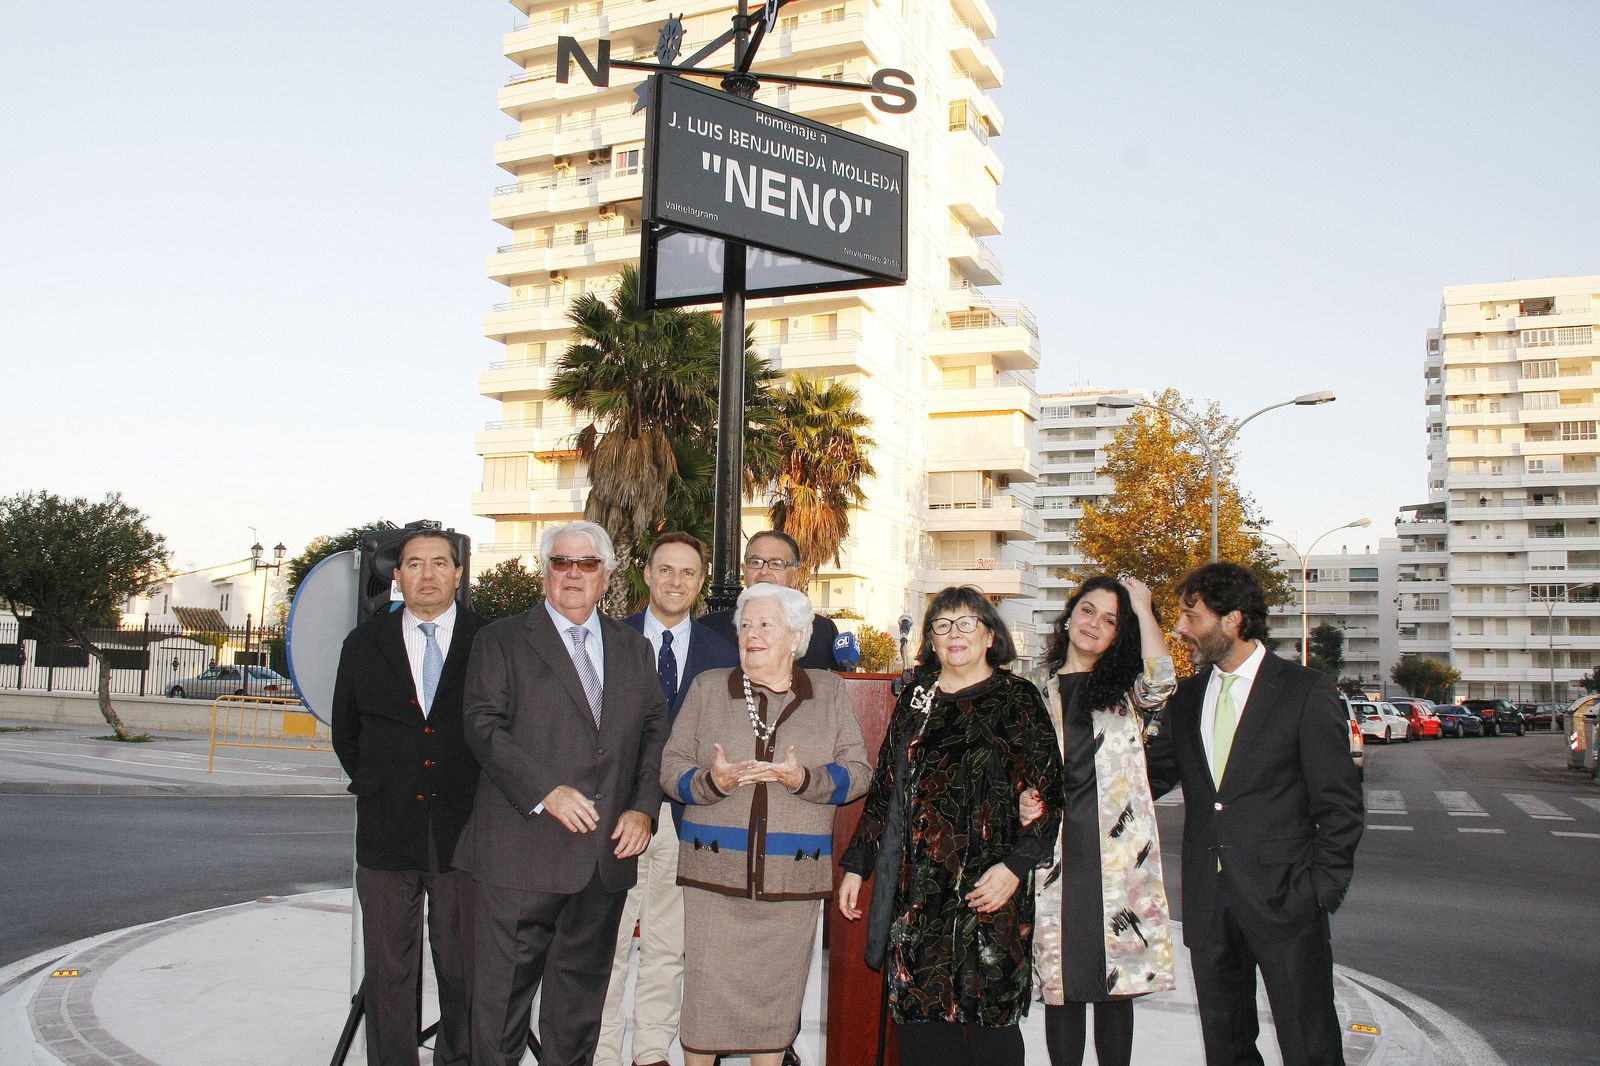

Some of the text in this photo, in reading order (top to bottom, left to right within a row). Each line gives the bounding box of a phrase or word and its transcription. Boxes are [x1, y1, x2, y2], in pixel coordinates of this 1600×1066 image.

[556, 36, 611, 87] N
[870, 68, 917, 114] S
[755, 111, 828, 144] Homenaje a
[668, 111, 900, 194] J. LUIS BENJUMEDA MOLLEDA
[664, 200, 719, 221] Valdelagrana
[702, 151, 872, 233] "NENO"
[843, 247, 882, 264] Noviembre
